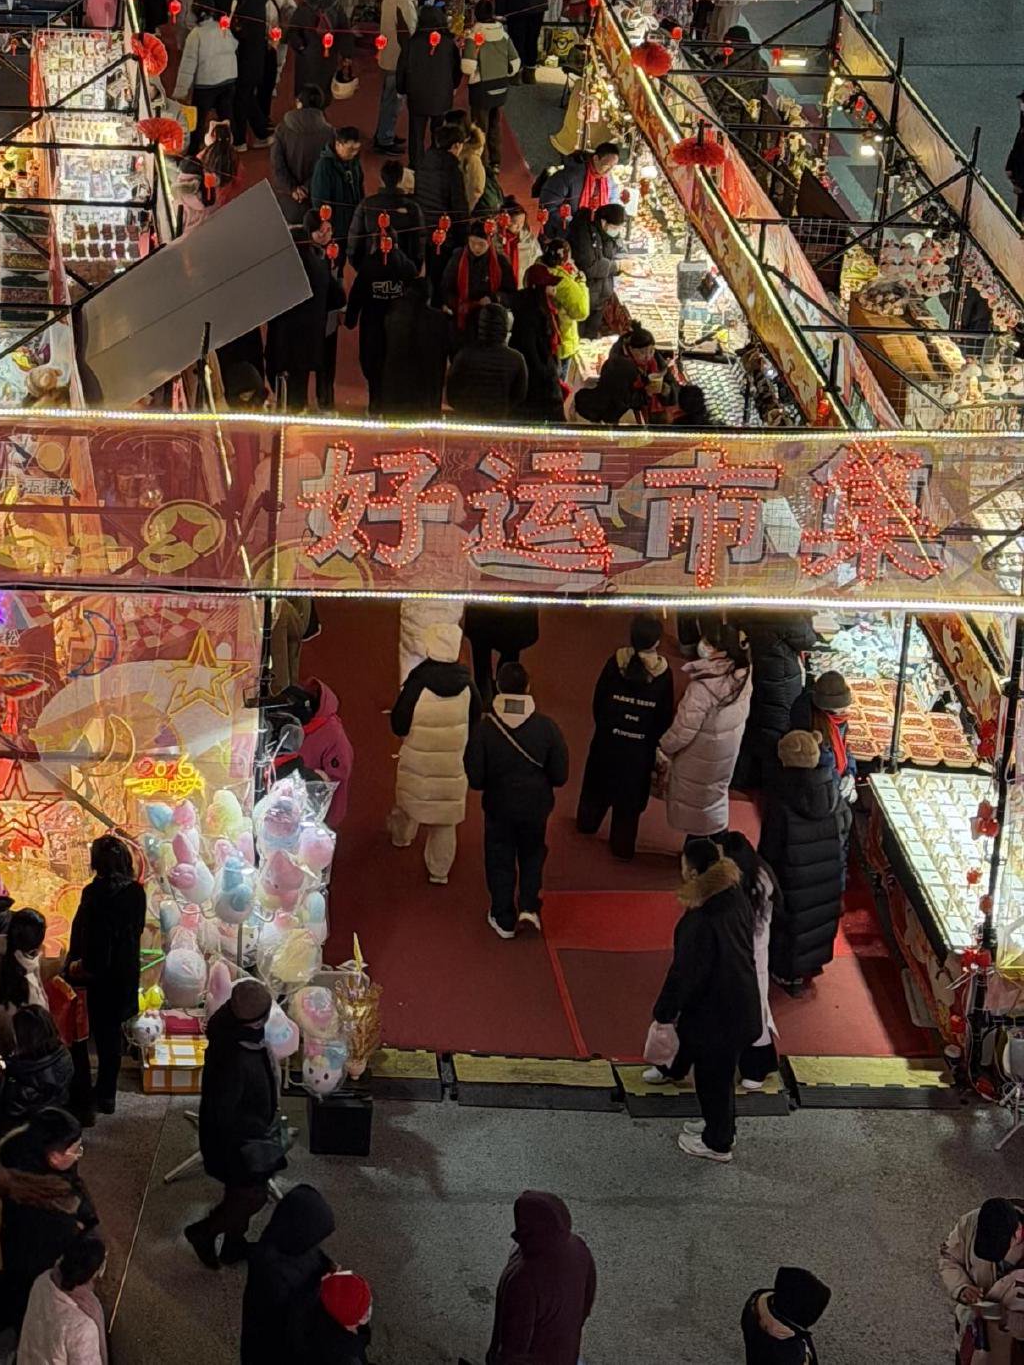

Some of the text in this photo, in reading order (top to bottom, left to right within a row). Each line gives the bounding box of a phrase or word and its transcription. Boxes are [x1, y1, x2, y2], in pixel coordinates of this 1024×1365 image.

[298, 439, 949, 590] 好运市集
[136, 753, 194, 778] 2026
